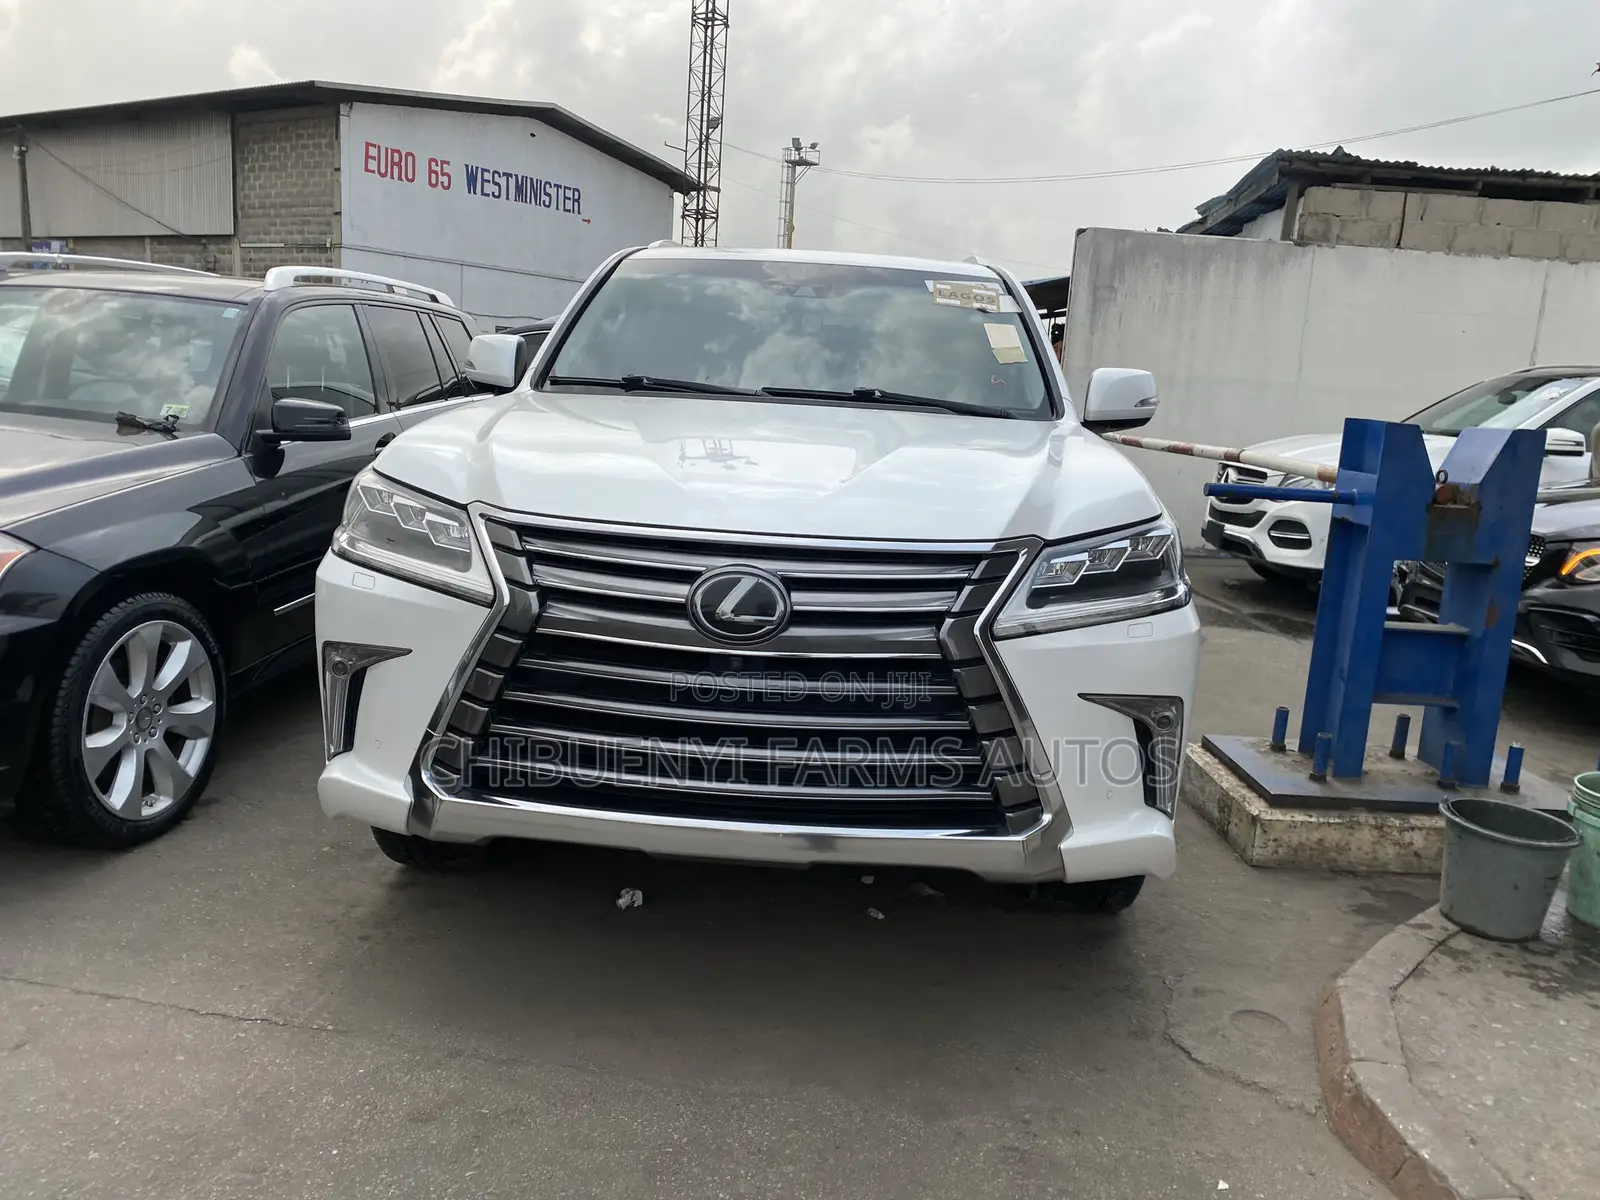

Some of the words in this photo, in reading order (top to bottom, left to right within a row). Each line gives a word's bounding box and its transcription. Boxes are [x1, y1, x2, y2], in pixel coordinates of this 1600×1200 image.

[364, 141, 416, 183] EURO
[427, 157, 452, 191] 65
[464, 163, 582, 215] WESTMINISTER
[938, 289, 996, 304] LAGOS
